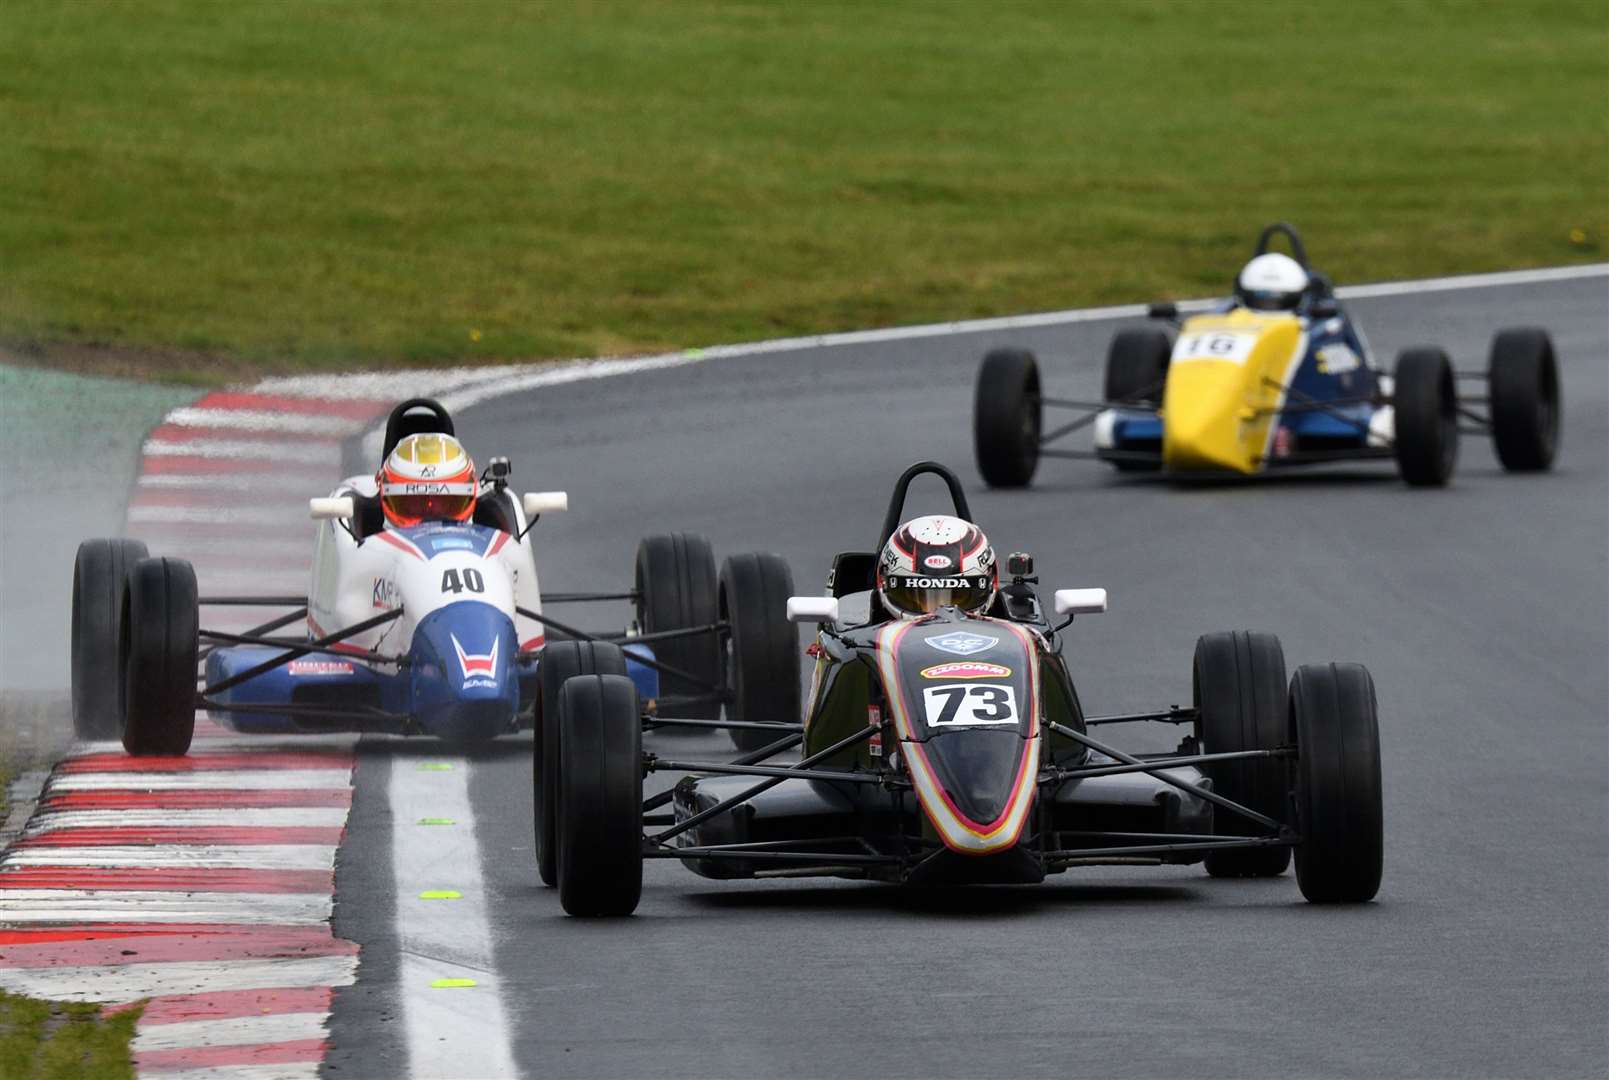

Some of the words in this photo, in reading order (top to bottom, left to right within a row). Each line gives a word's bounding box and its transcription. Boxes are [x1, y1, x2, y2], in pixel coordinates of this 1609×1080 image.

[1190, 337, 1235, 354] 16
[405, 484, 450, 493] ROSA
[927, 557, 947, 565] BELL
[441, 567, 485, 593] 40
[905, 578, 971, 588] HONDA
[931, 686, 1012, 723] 73
